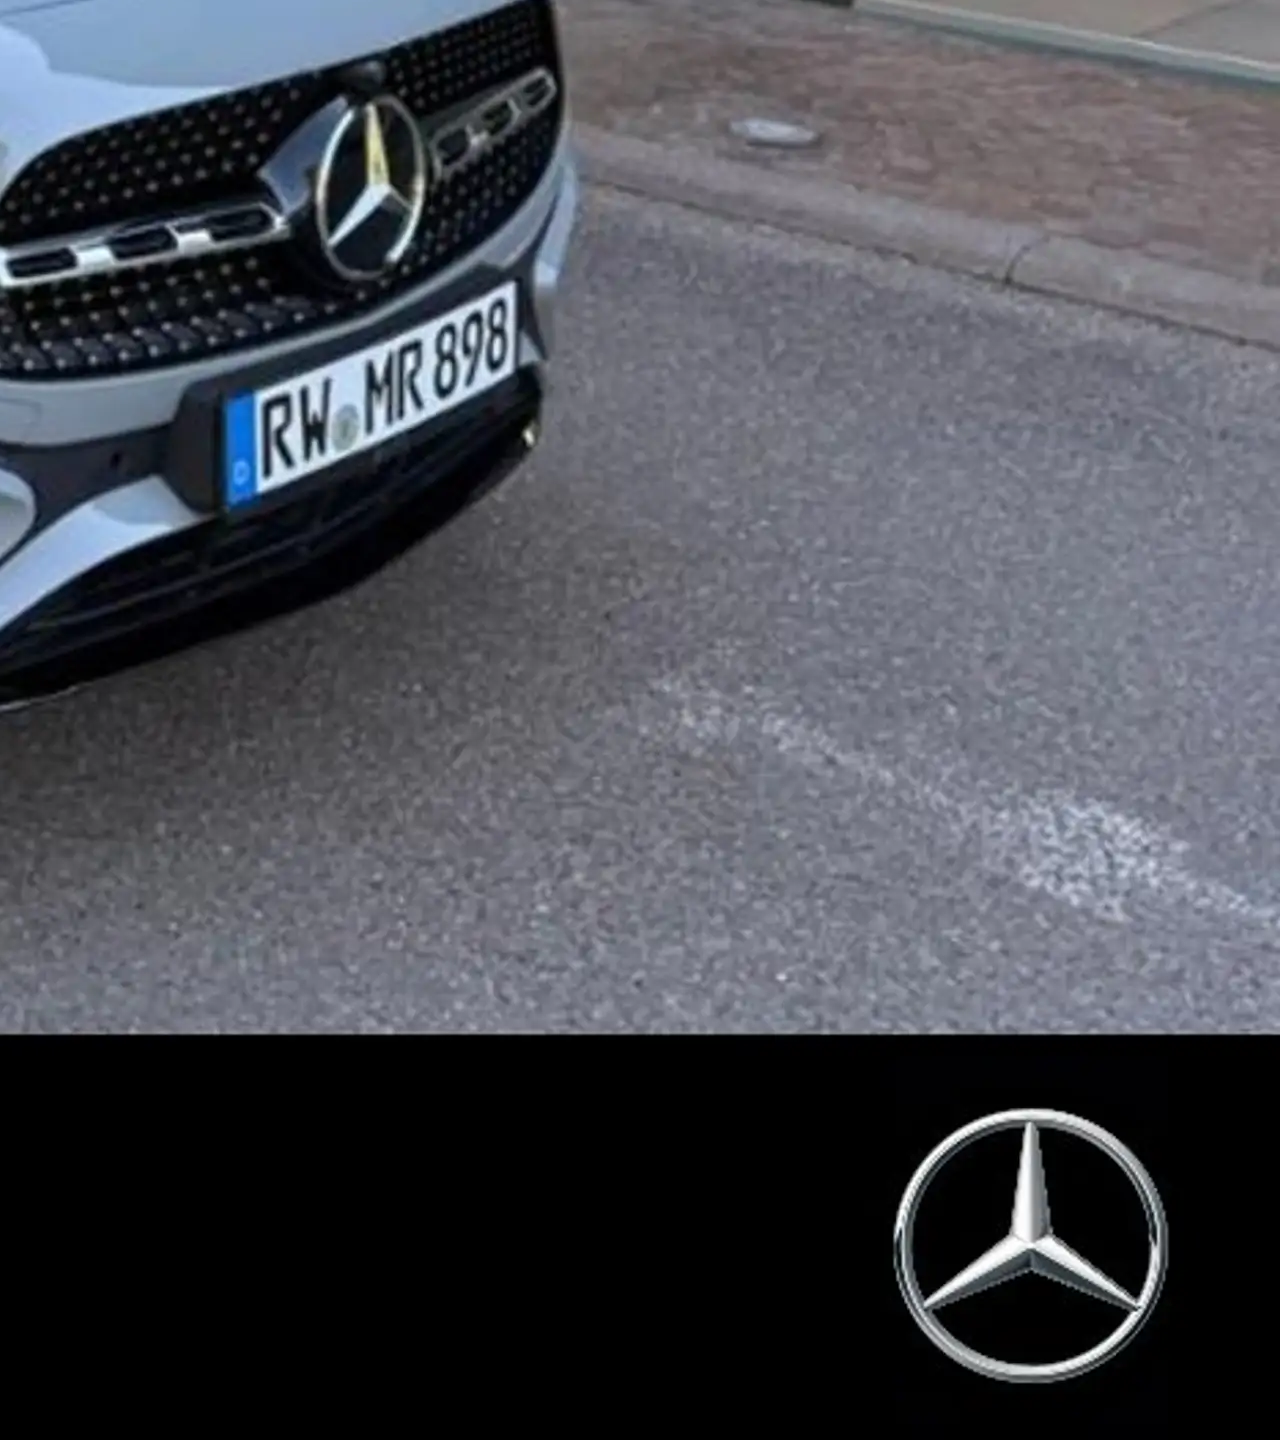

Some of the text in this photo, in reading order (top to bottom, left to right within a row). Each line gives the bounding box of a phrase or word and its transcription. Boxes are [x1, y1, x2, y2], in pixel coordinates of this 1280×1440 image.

[261, 297, 508, 478] RW MR 898
[232, 460, 251, 486] D
